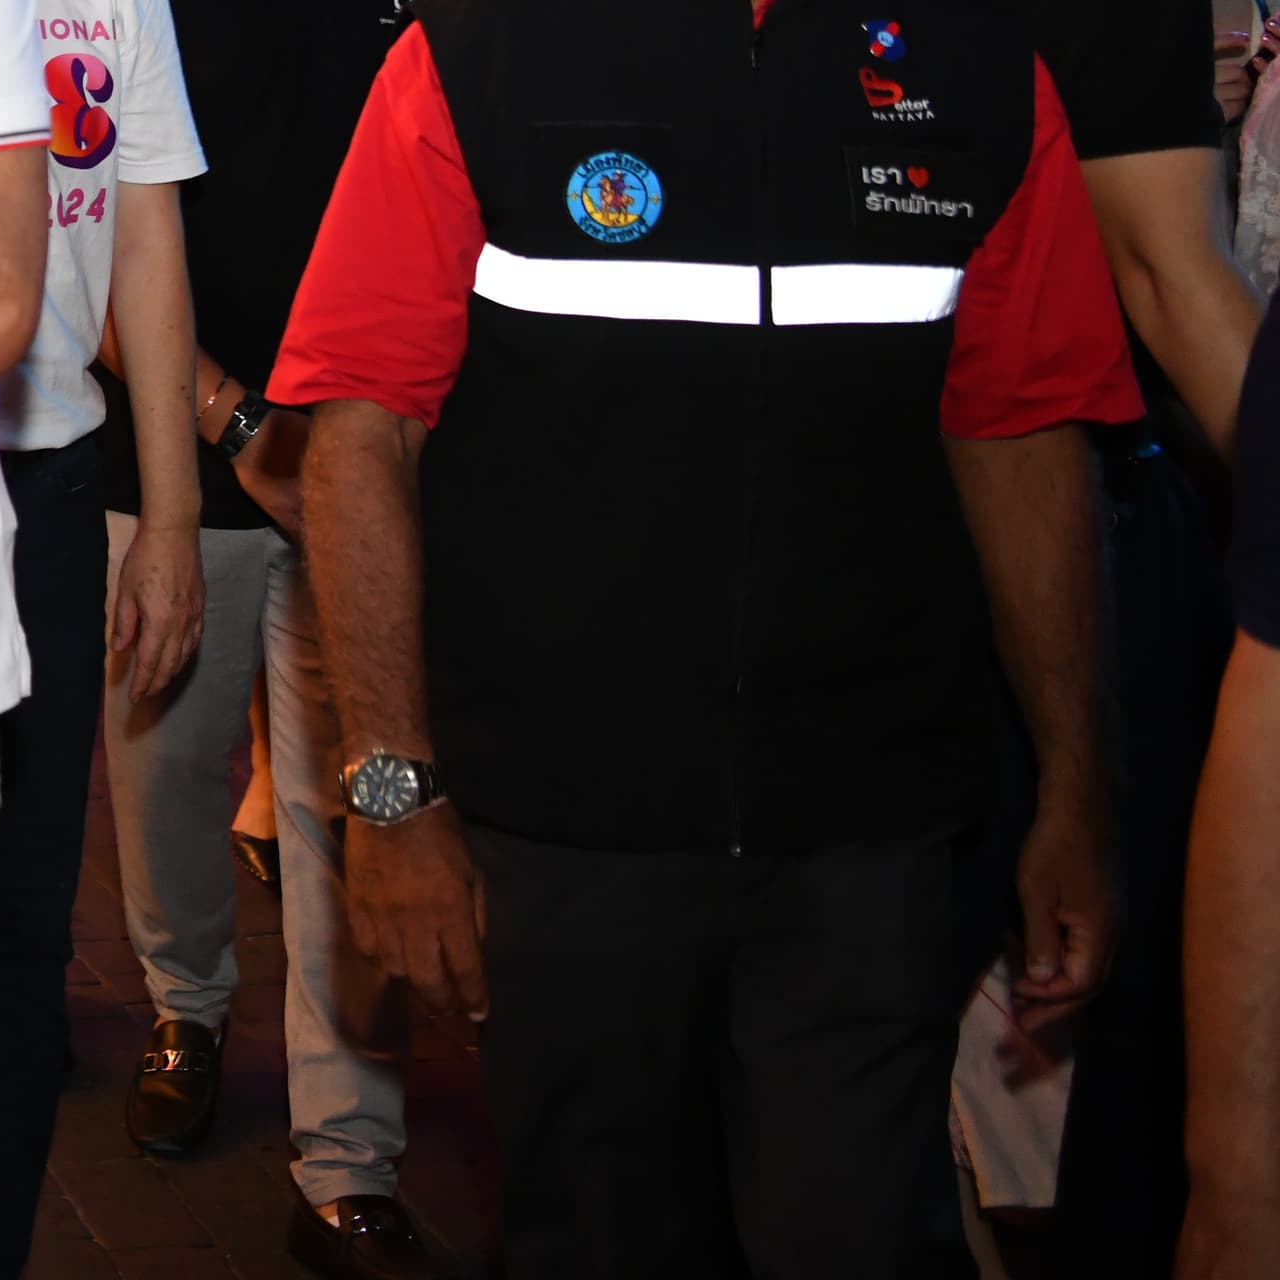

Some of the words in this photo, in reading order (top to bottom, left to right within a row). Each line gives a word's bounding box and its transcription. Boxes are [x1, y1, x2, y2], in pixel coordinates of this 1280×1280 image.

[862, 166, 903, 185] เรา
[865, 190, 974, 219] รักพัทยา
